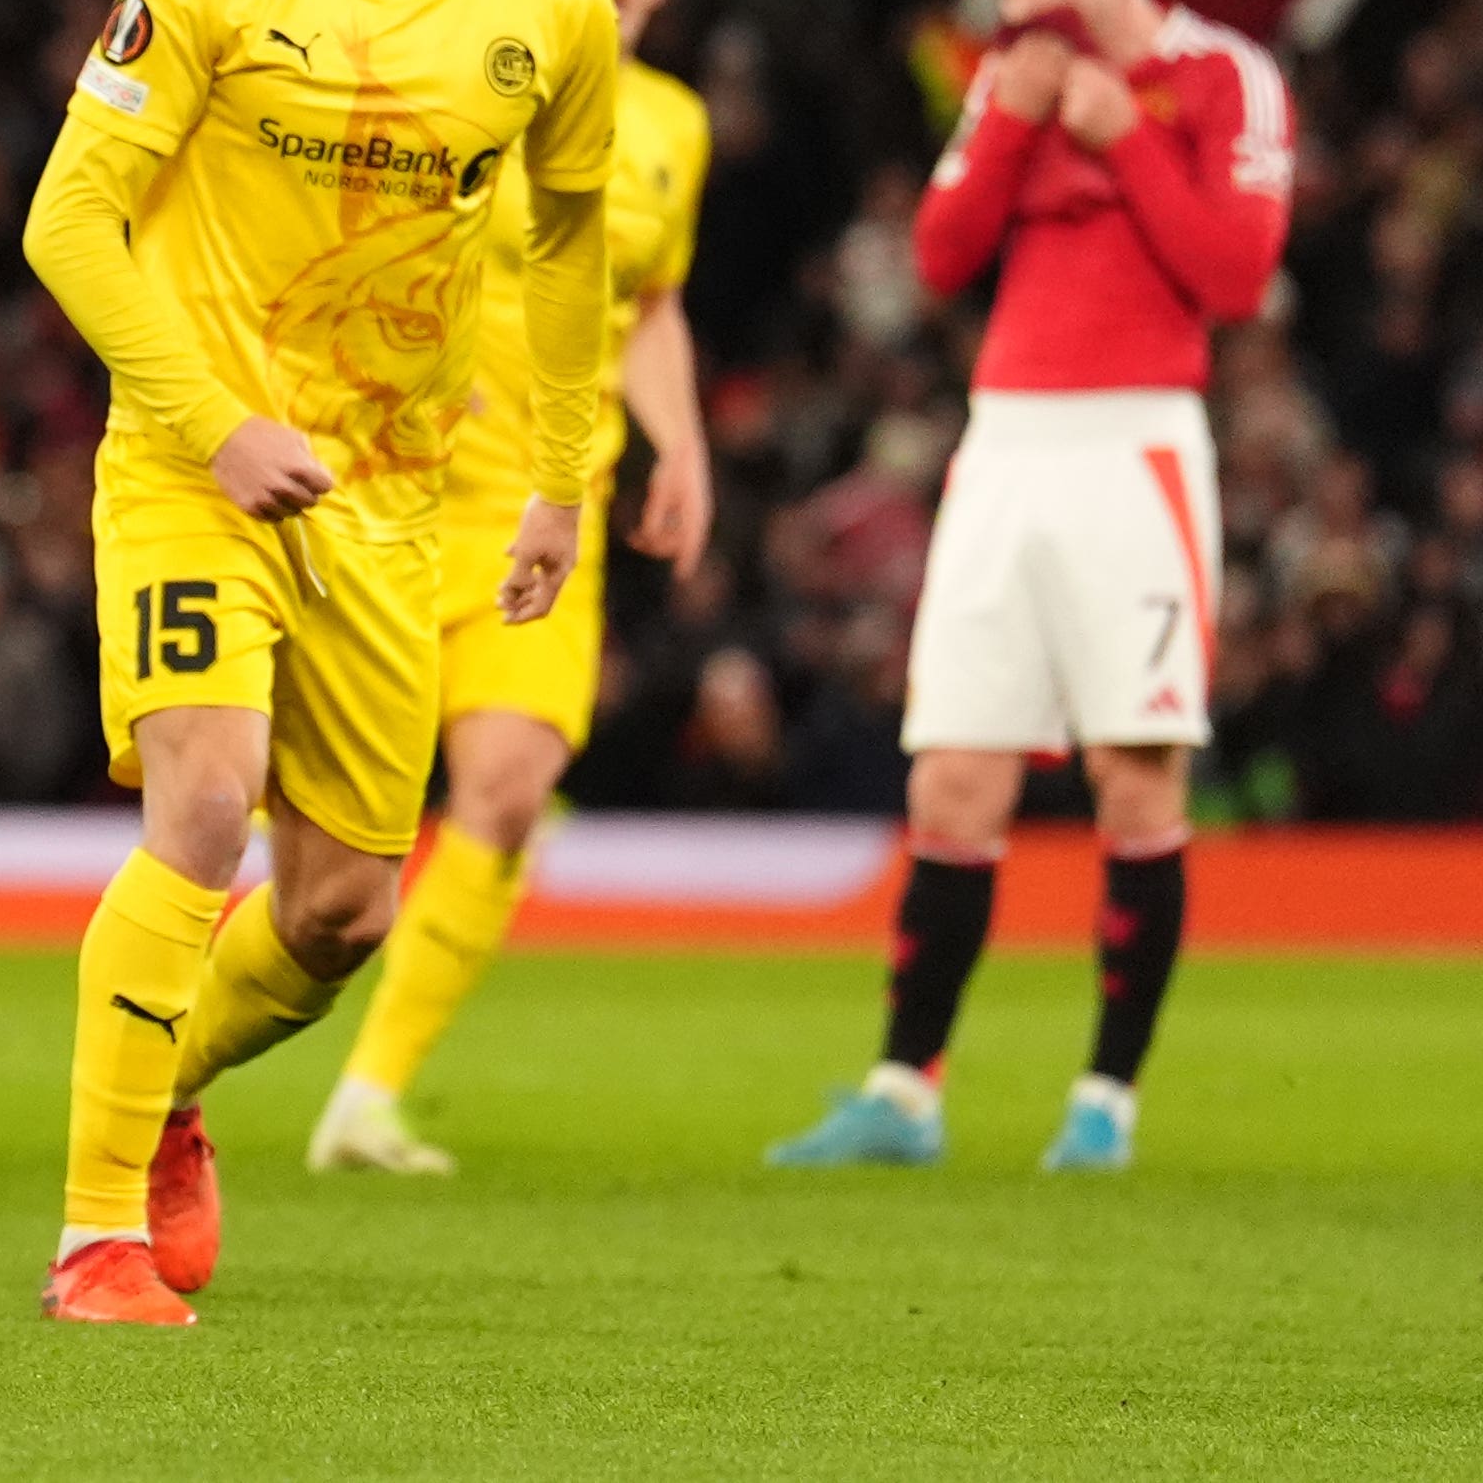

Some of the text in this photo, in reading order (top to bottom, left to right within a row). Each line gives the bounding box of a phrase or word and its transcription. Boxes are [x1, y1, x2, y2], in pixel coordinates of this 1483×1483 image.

[258, 118, 457, 178] SpareBank
[134, 580, 217, 680] 15
[1141, 594, 1182, 672] 7
